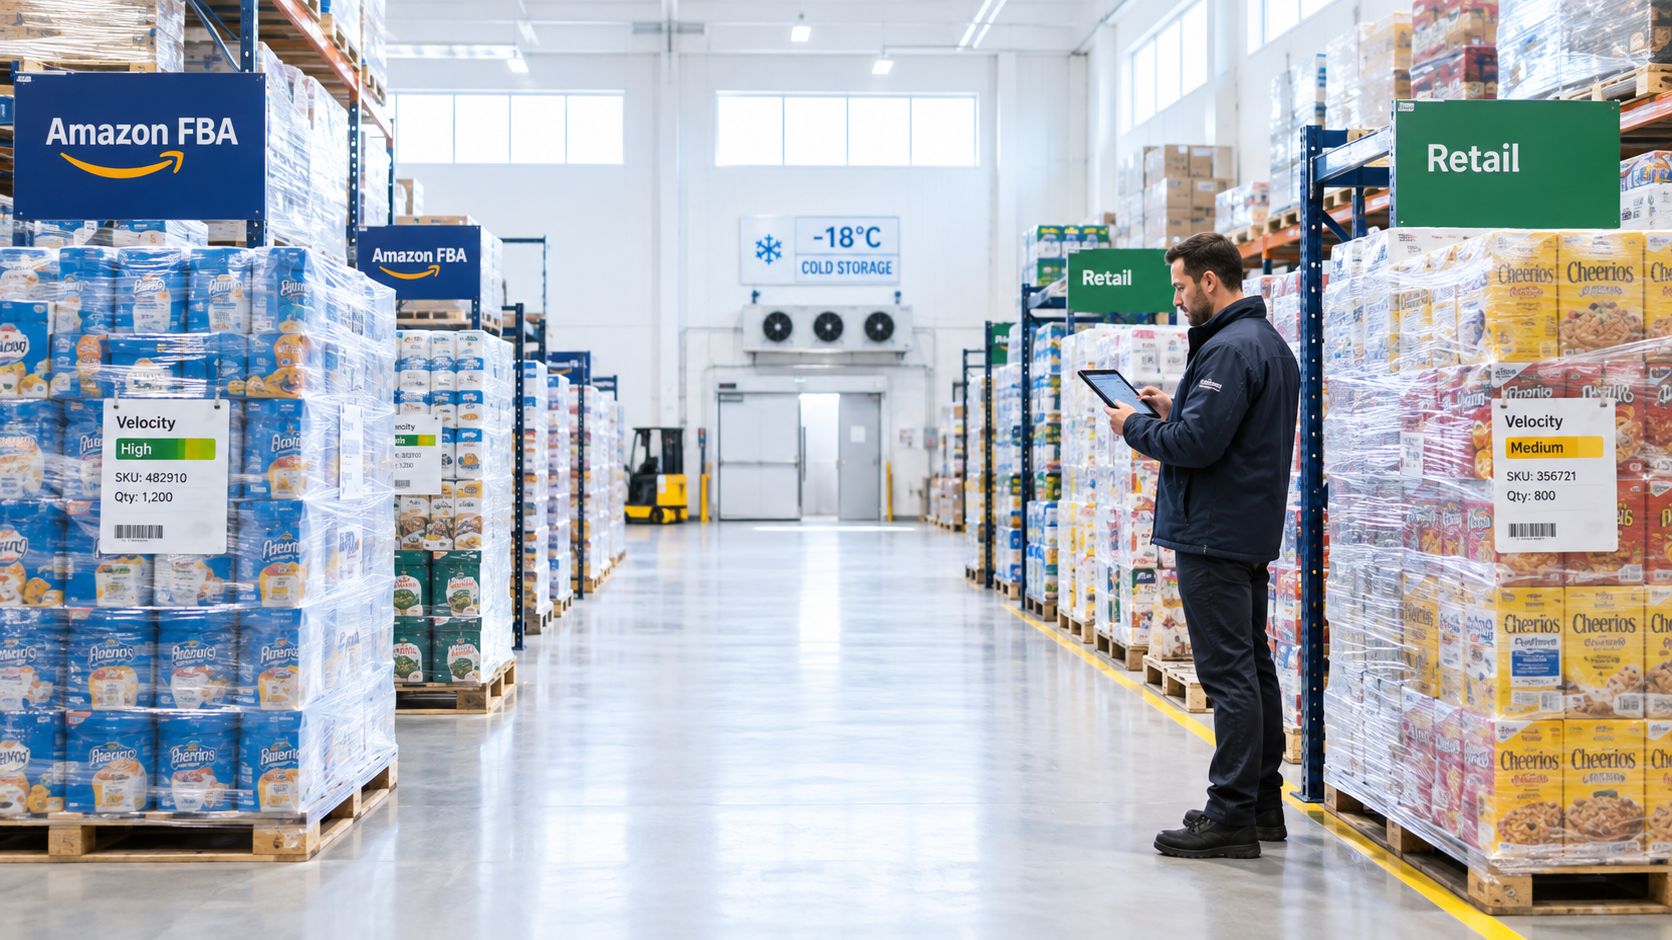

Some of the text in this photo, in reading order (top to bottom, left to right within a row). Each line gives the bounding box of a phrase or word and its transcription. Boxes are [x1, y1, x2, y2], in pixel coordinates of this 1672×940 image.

[46, 117, 238, 146] Amazon FBA
[1427, 143, 1520, 173] Retail
[813, 226, 881, 249] -18°C
[372, 248, 467, 263] Amazon FBA
[801, 261, 892, 275] COLD STORAGE
[1498, 263, 1554, 284] Cheerios
[1567, 261, 1634, 283] Cheerios
[1082, 269, 1132, 286] Retail
[117, 416, 176, 432] Velocity
[1505, 414, 1563, 430] Velocity
[121, 442, 152, 457] High
[1511, 442, 1563, 454] Medium
[115, 472, 188, 484] SKU: 482910
[1507, 471, 1576, 482] SKU: 356721
[115, 491, 173, 504] Qty: 1,200
[1507, 490, 1556, 504] Qty: 800
[1572, 613, 1636, 633] Cheerios
[1500, 750, 1559, 771] Cheerios
[1571, 748, 1636, 770] Cheerios
